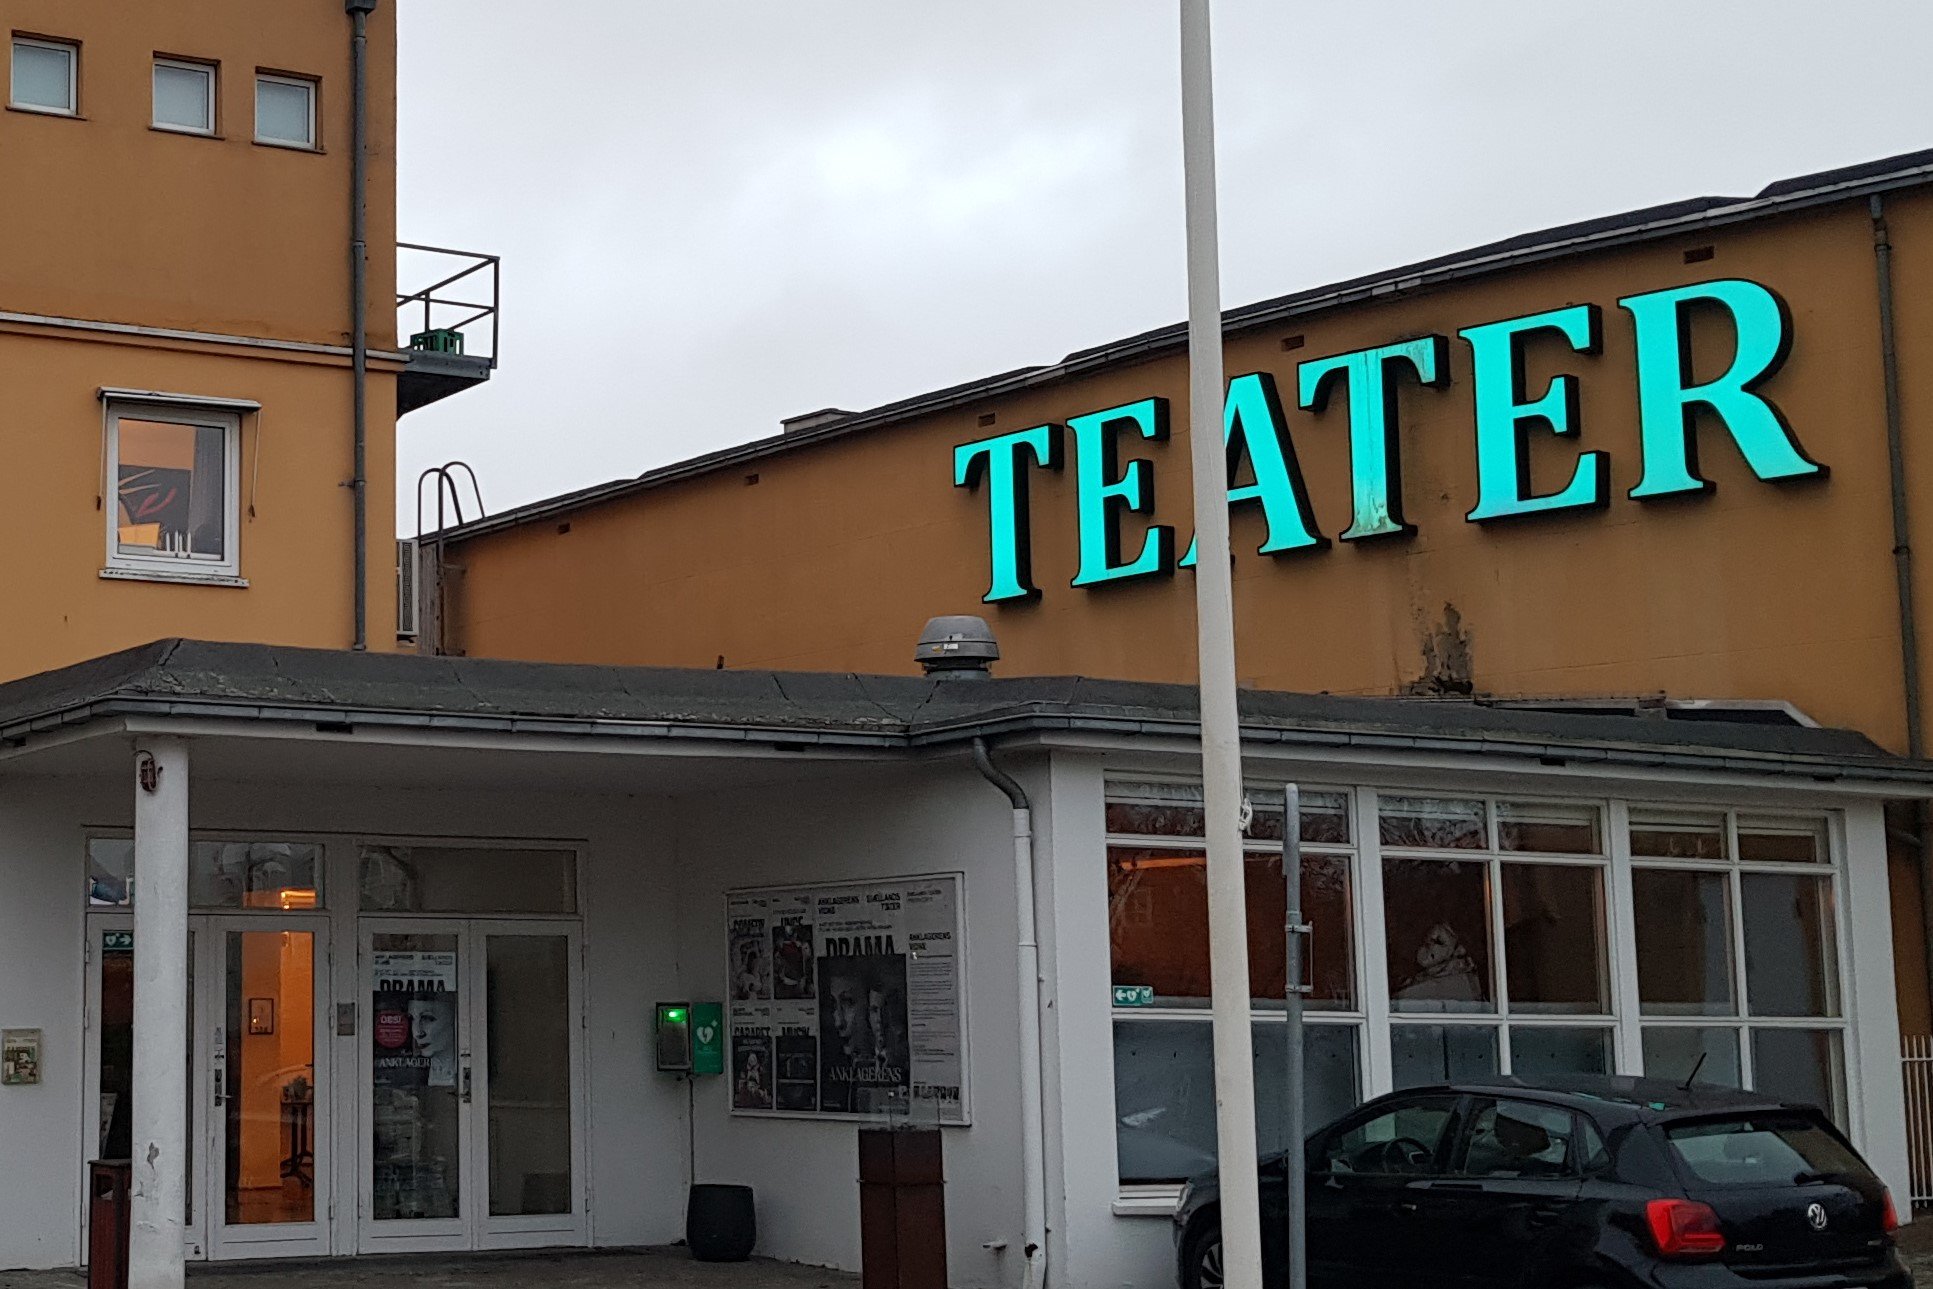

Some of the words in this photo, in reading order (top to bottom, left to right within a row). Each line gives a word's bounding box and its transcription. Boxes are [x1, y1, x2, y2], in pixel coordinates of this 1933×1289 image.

[953, 278, 1830, 604] TEATER
[380, 979, 446, 992] DRAMA
[379, 1057, 431, 1068] ANKLAGER
[1735, 1243, 1764, 1252] POLO
